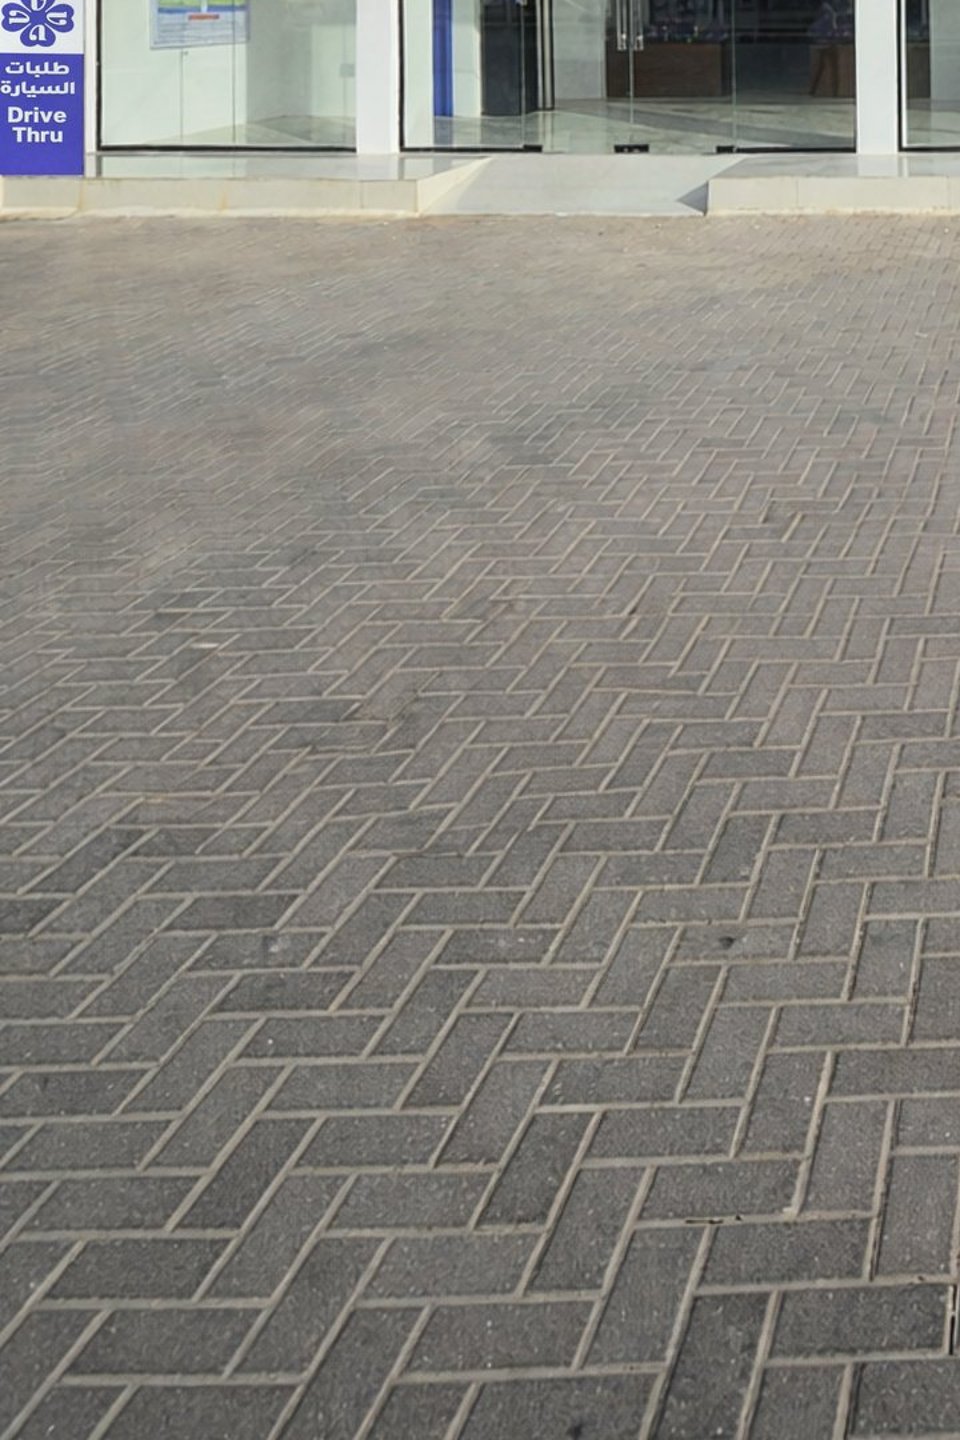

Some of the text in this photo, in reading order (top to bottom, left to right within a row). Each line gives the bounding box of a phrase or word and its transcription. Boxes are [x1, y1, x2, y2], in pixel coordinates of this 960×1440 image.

[5, 61, 70, 78] طلبات
[0, 80, 75, 98] السيارة
[7, 106, 67, 124] Drive
[12, 126, 63, 143] Thru
